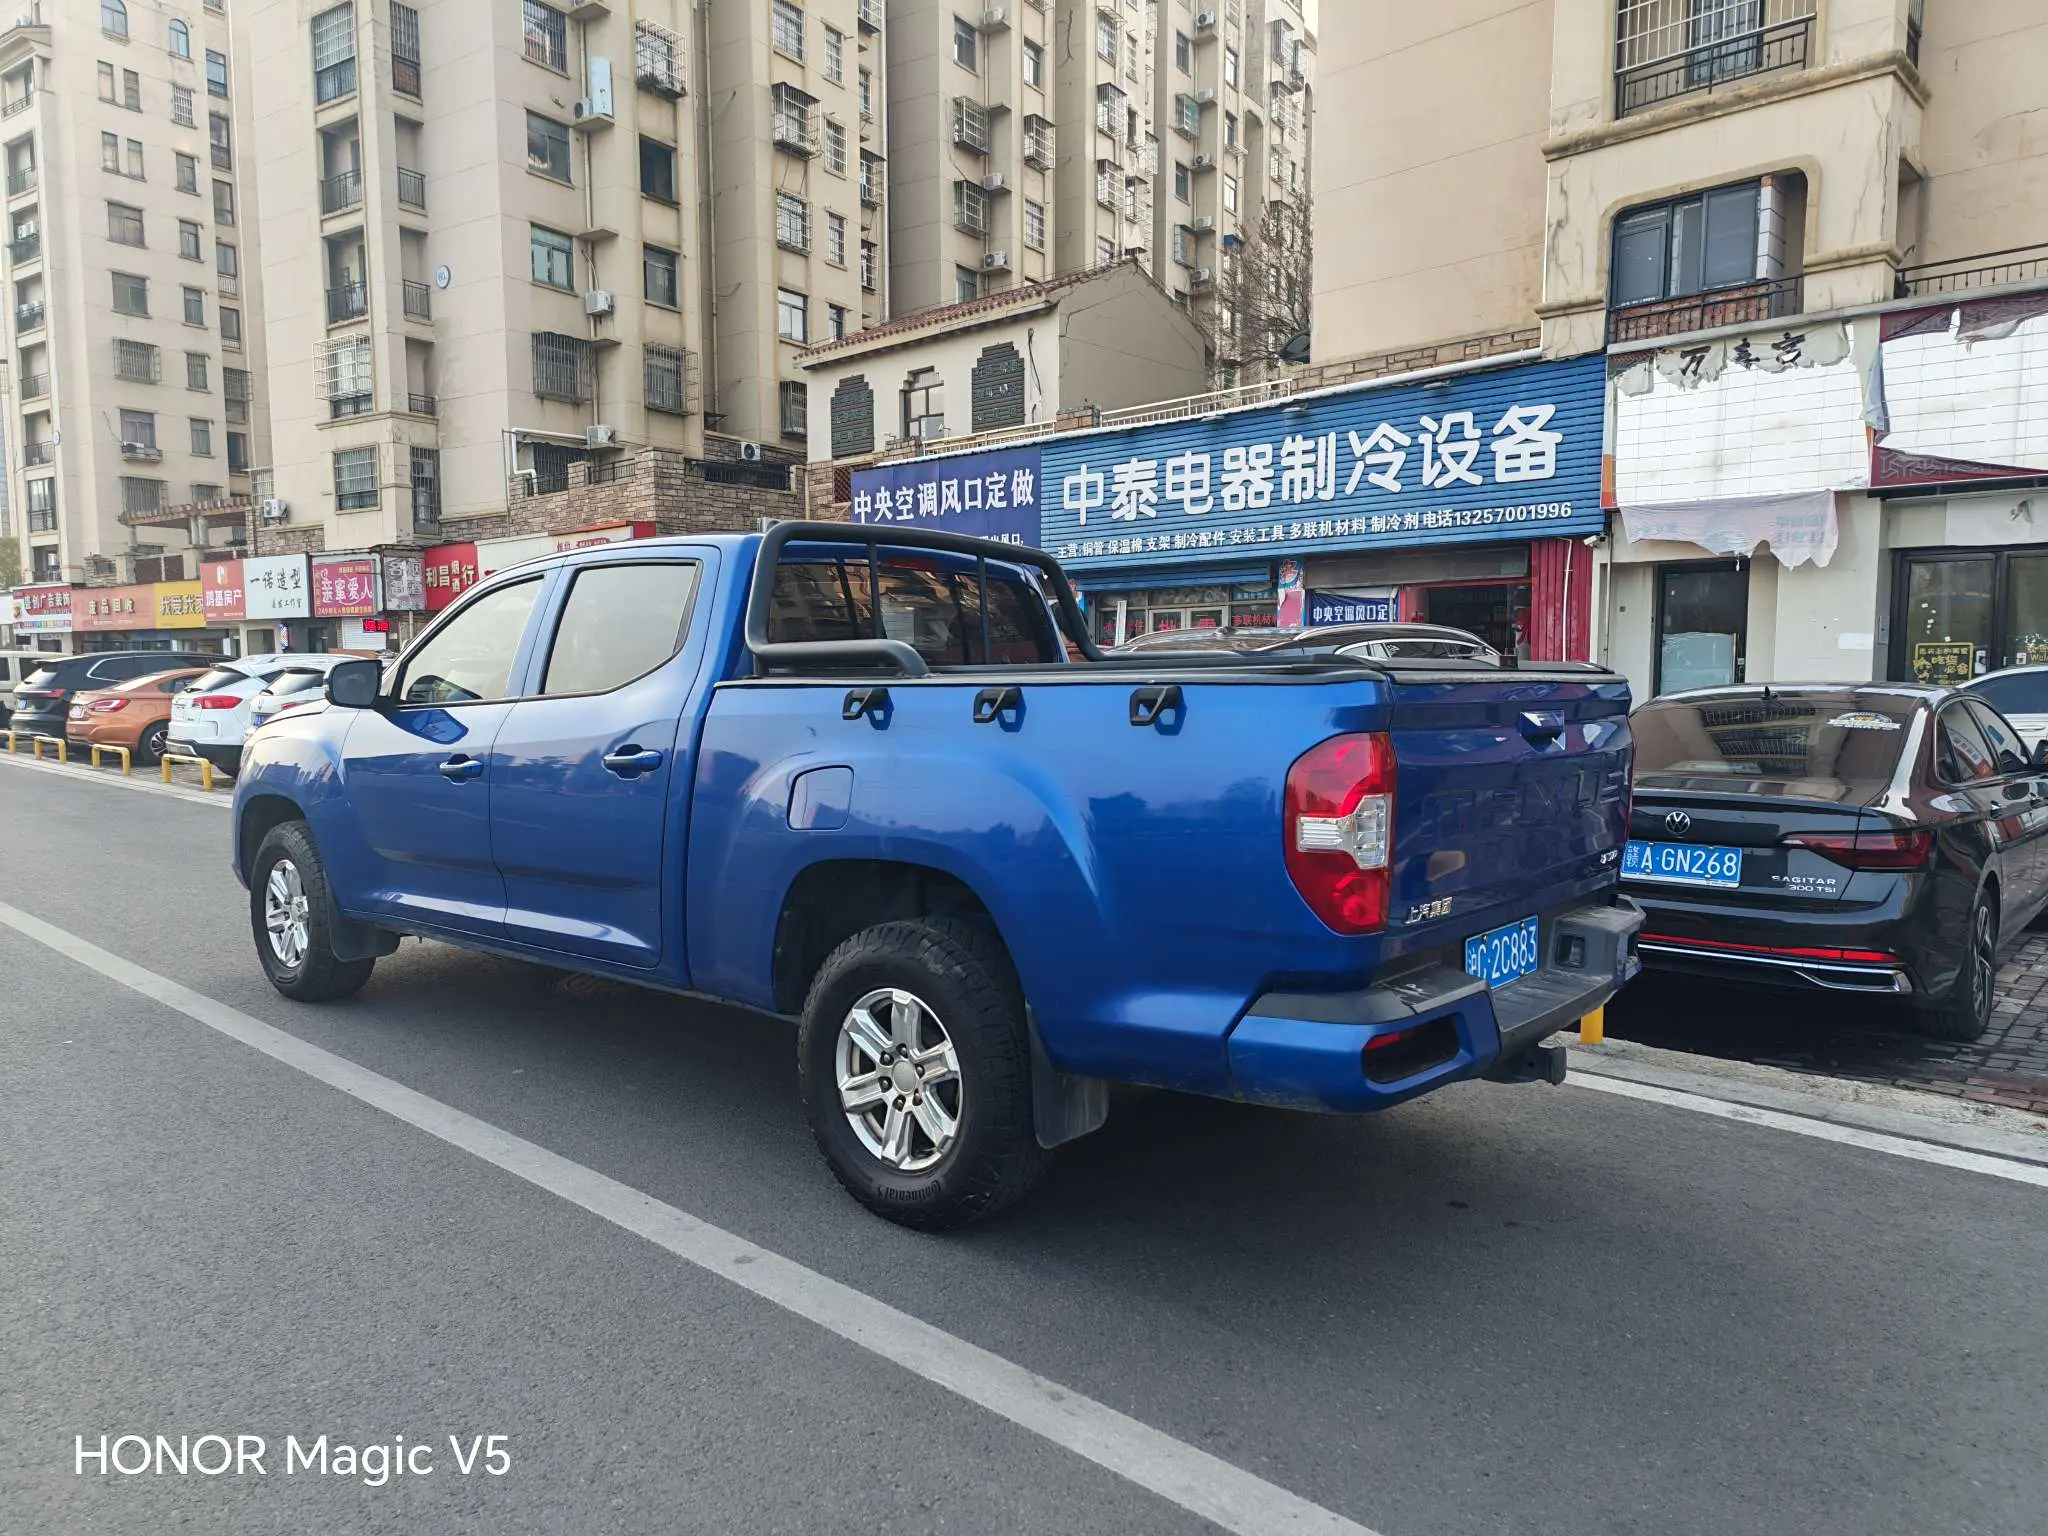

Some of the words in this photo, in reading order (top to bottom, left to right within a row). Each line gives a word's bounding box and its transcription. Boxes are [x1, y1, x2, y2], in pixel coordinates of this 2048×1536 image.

[1063, 404, 1563, 526] 中泰电器制冷设备
[854, 468, 1034, 524] 中央空调风口定做
[1108, 538, 1142, 554] 保温棉
[1146, 535, 1171, 551] 支架
[1174, 530, 1225, 549] 制冷配件
[1230, 525, 1285, 545] 安装工具
[1290, 517, 1366, 539] 多联机材料
[1371, 512, 1419, 533] 制冷剂
[250, 566, 301, 590] 一诺造型
[160, 593, 204, 616] 我爱我家
[1313, 603, 1397, 622] 中央空调风口定
[1771, 875, 1837, 885] SAGITAR
[1789, 884, 1814, 892] 300
